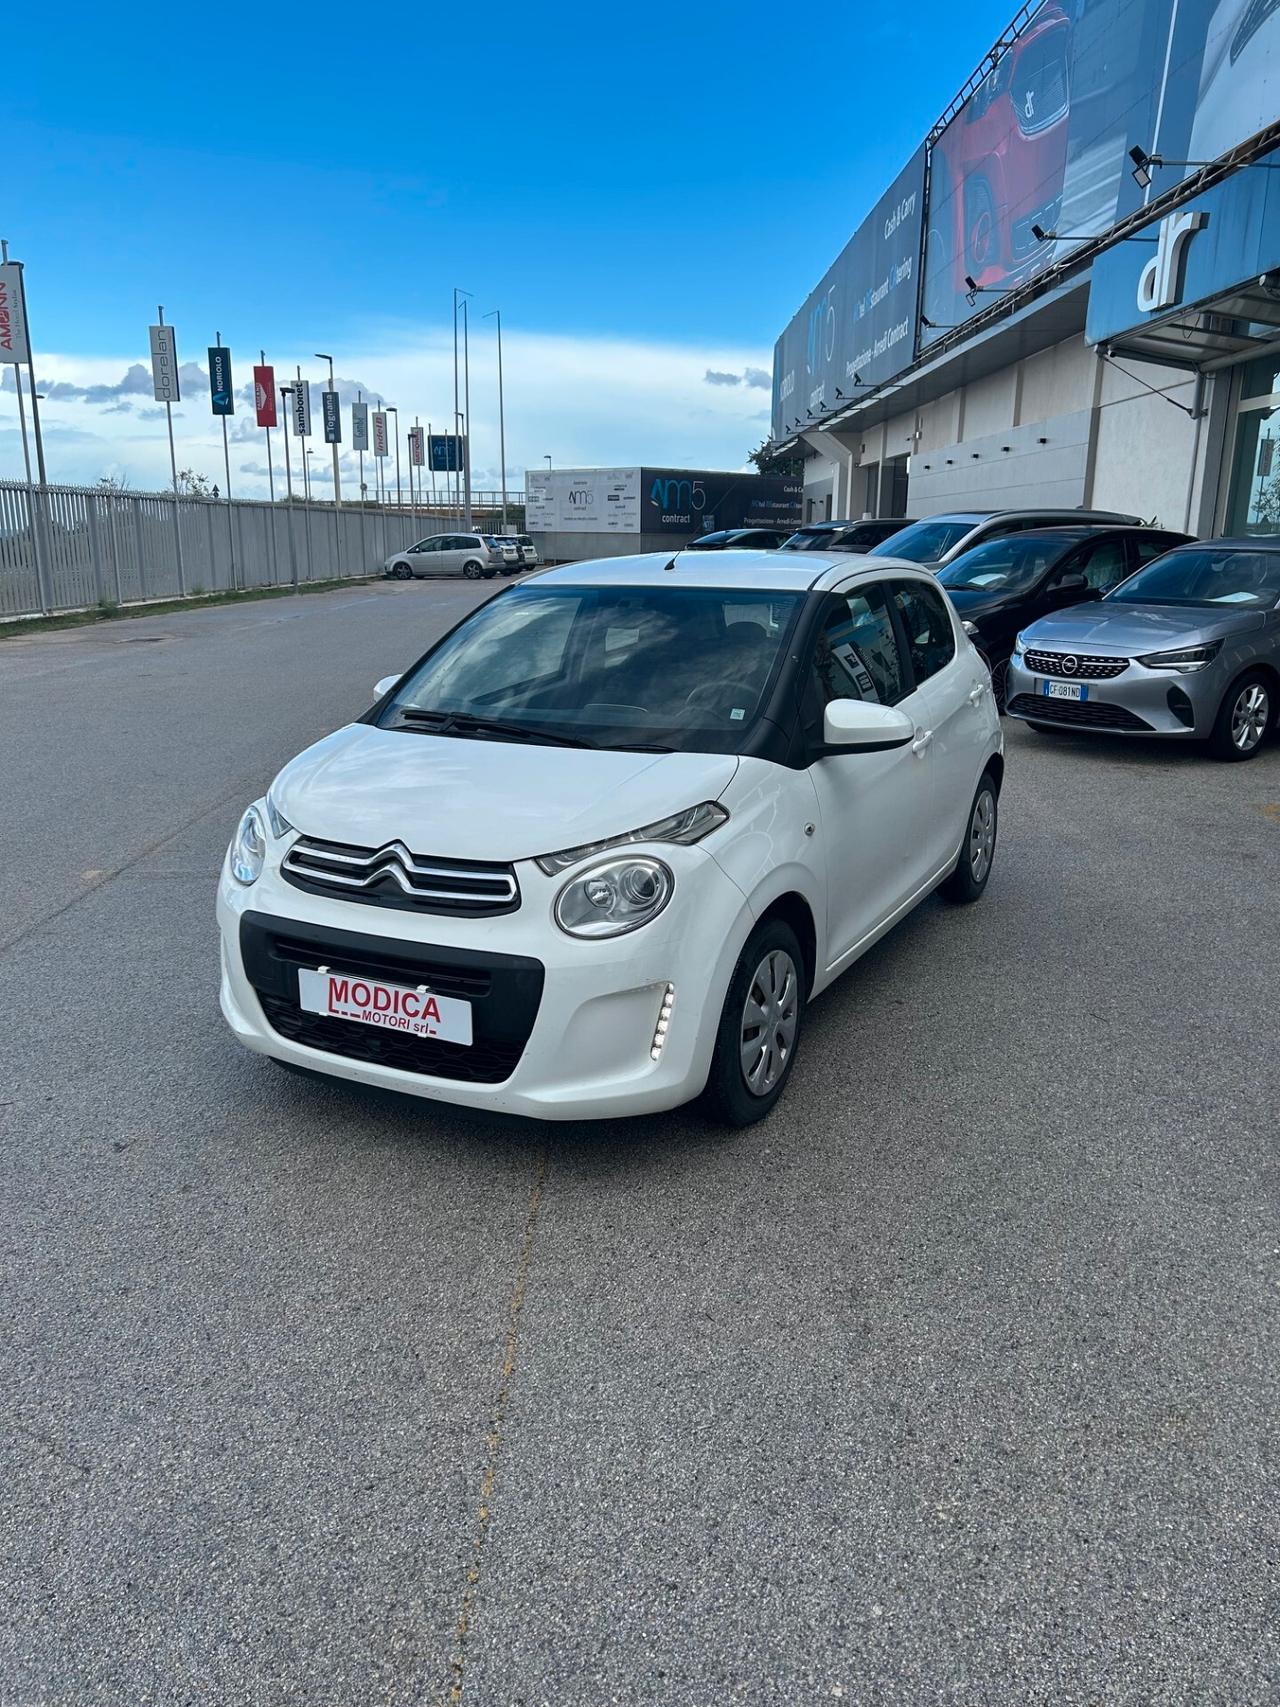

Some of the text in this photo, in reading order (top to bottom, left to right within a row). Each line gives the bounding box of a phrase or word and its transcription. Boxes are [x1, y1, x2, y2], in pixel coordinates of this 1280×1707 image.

[884, 210, 897, 240] Cash
[901, 191, 916, 221] Carry
[1137, 212, 1206, 312] dr
[888, 315, 908, 348] Contract
[152, 329, 171, 399] dorelan
[295, 382, 306, 434] sambonet
[326, 394, 336, 432] Tognana
[661, 513, 691, 525] contract
[328, 977, 441, 1024] MODICA
[361, 1009, 429, 1034] MOTORI srl
